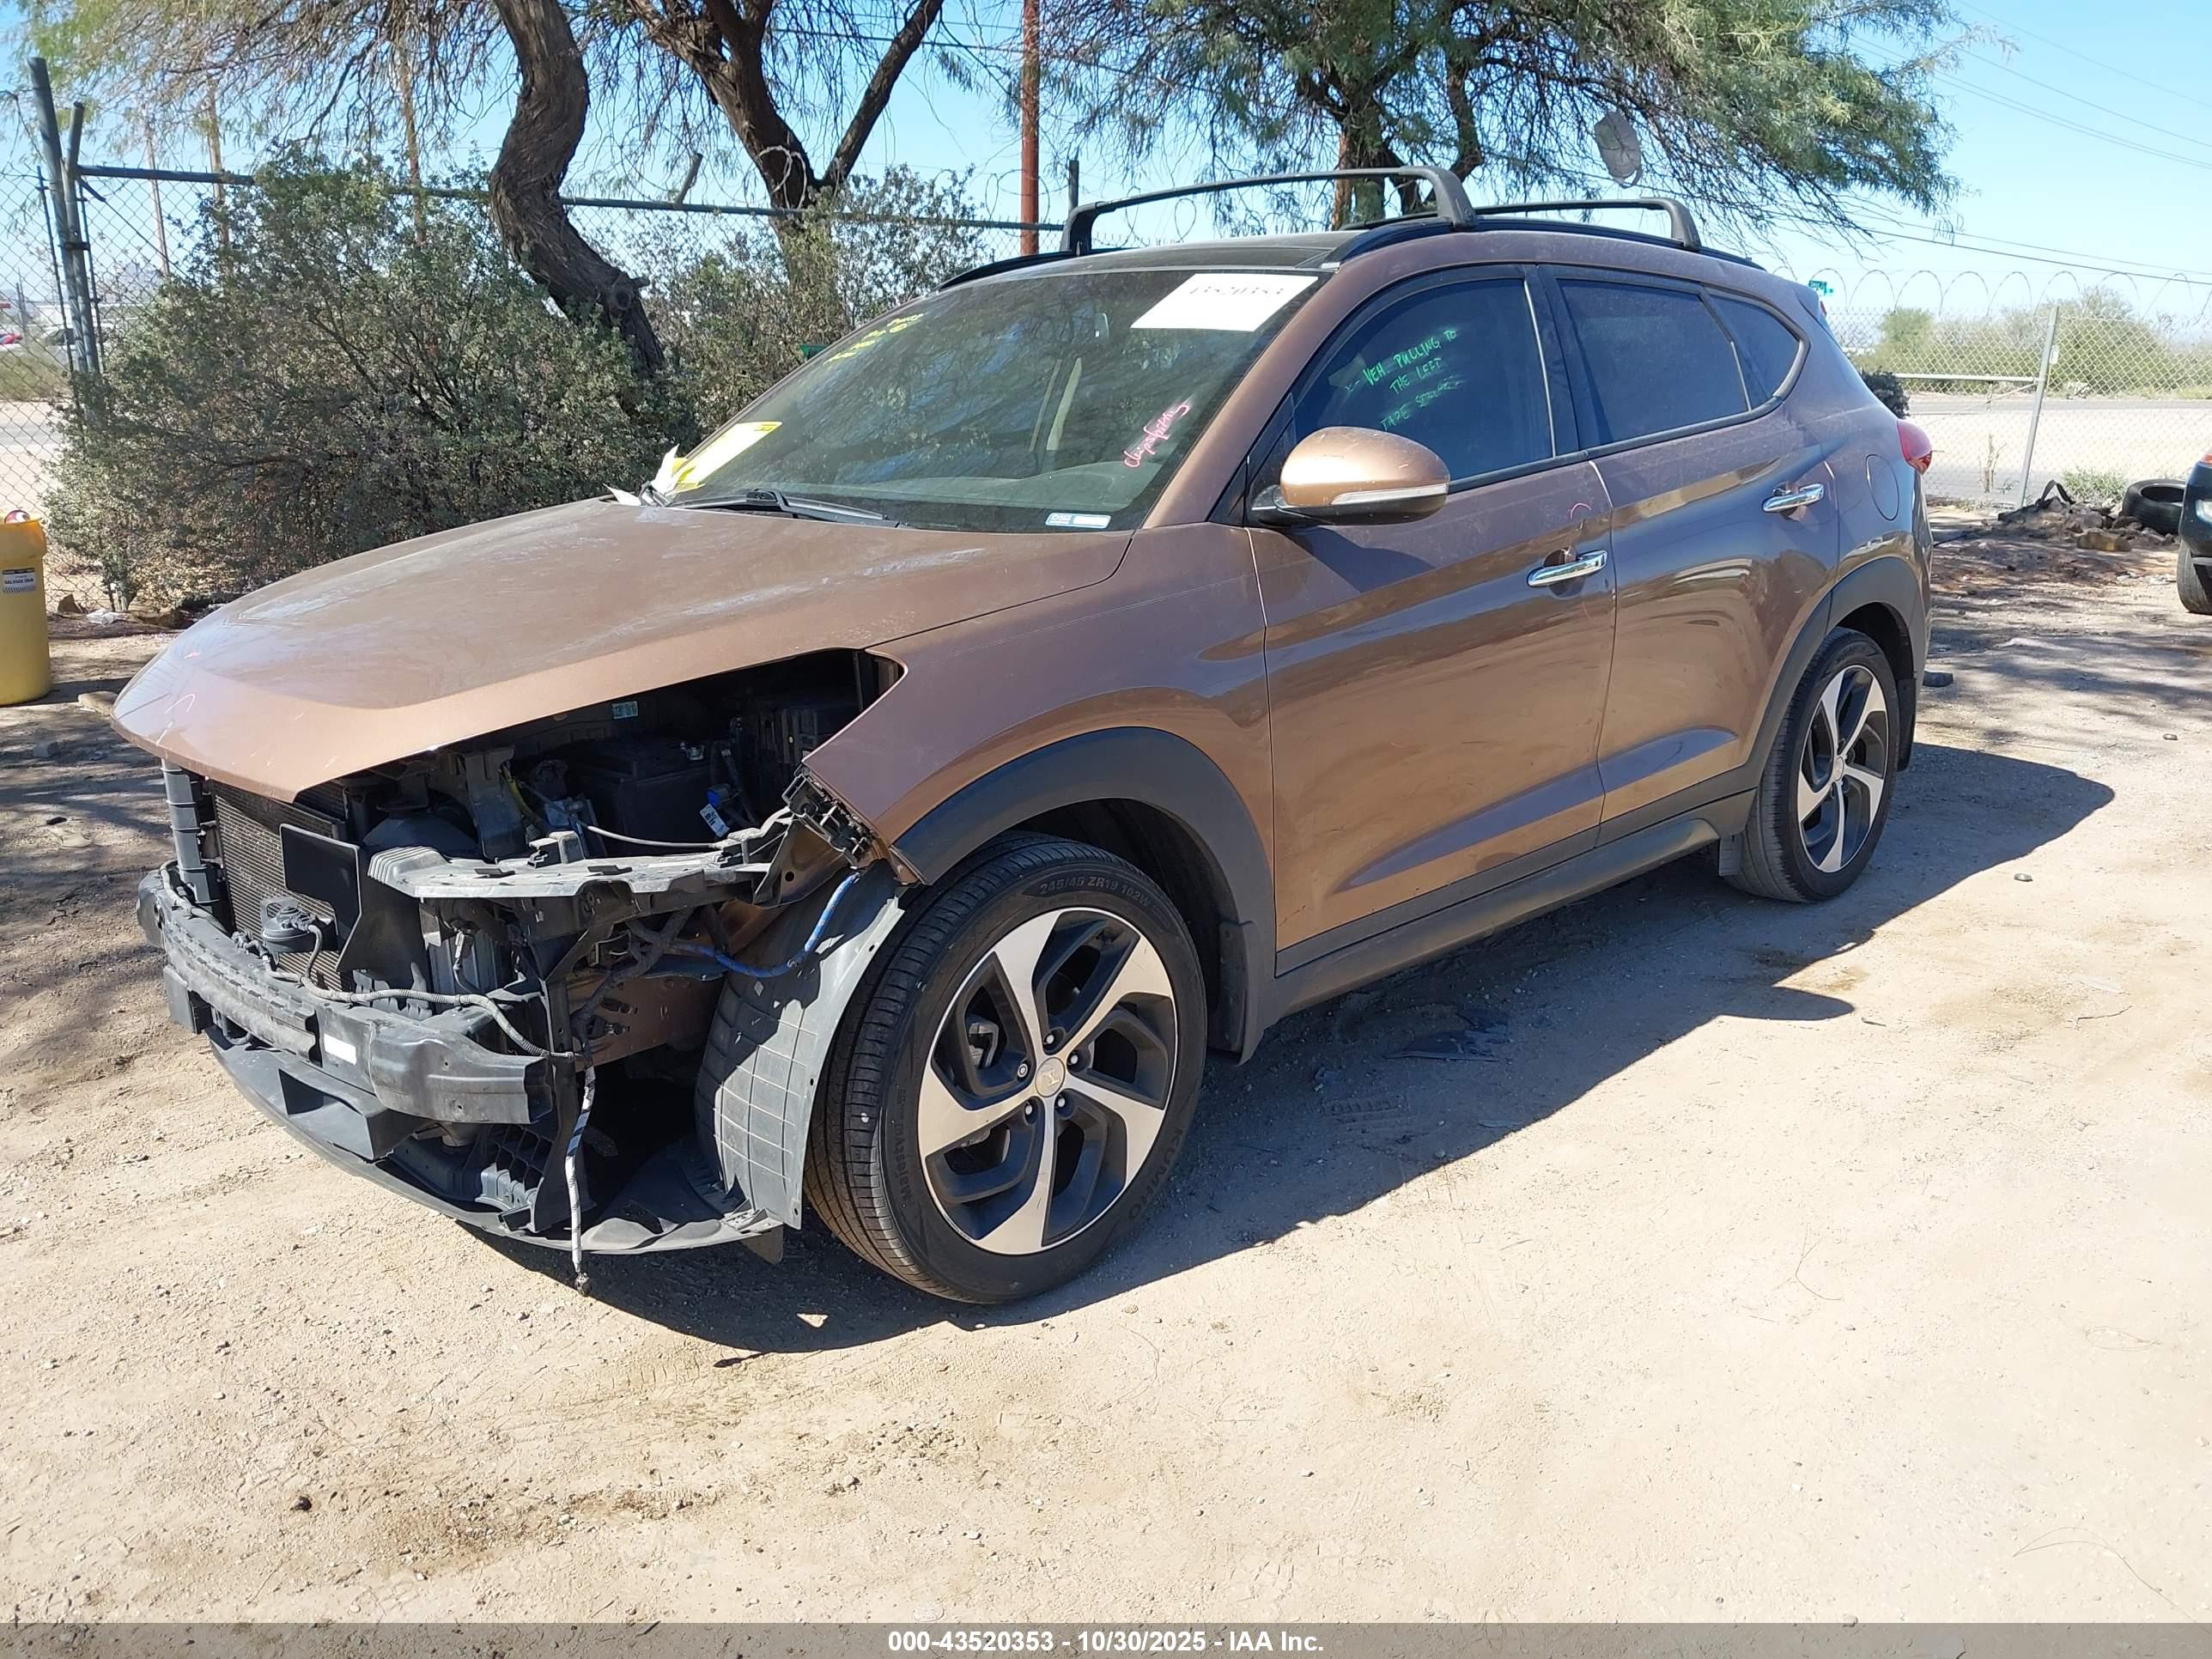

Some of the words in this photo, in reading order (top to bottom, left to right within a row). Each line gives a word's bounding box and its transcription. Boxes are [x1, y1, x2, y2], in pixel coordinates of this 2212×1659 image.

[1393, 337, 1441, 368] PULLING
[1443, 329, 1457, 343] TO
[1389, 374, 1410, 395] THE
[1416, 356, 1443, 379] LEFT
[1040, 876, 1085, 895] 245/45
[1087, 876, 1119, 890] ZR19
[1121, 884, 1152, 908] 102W
